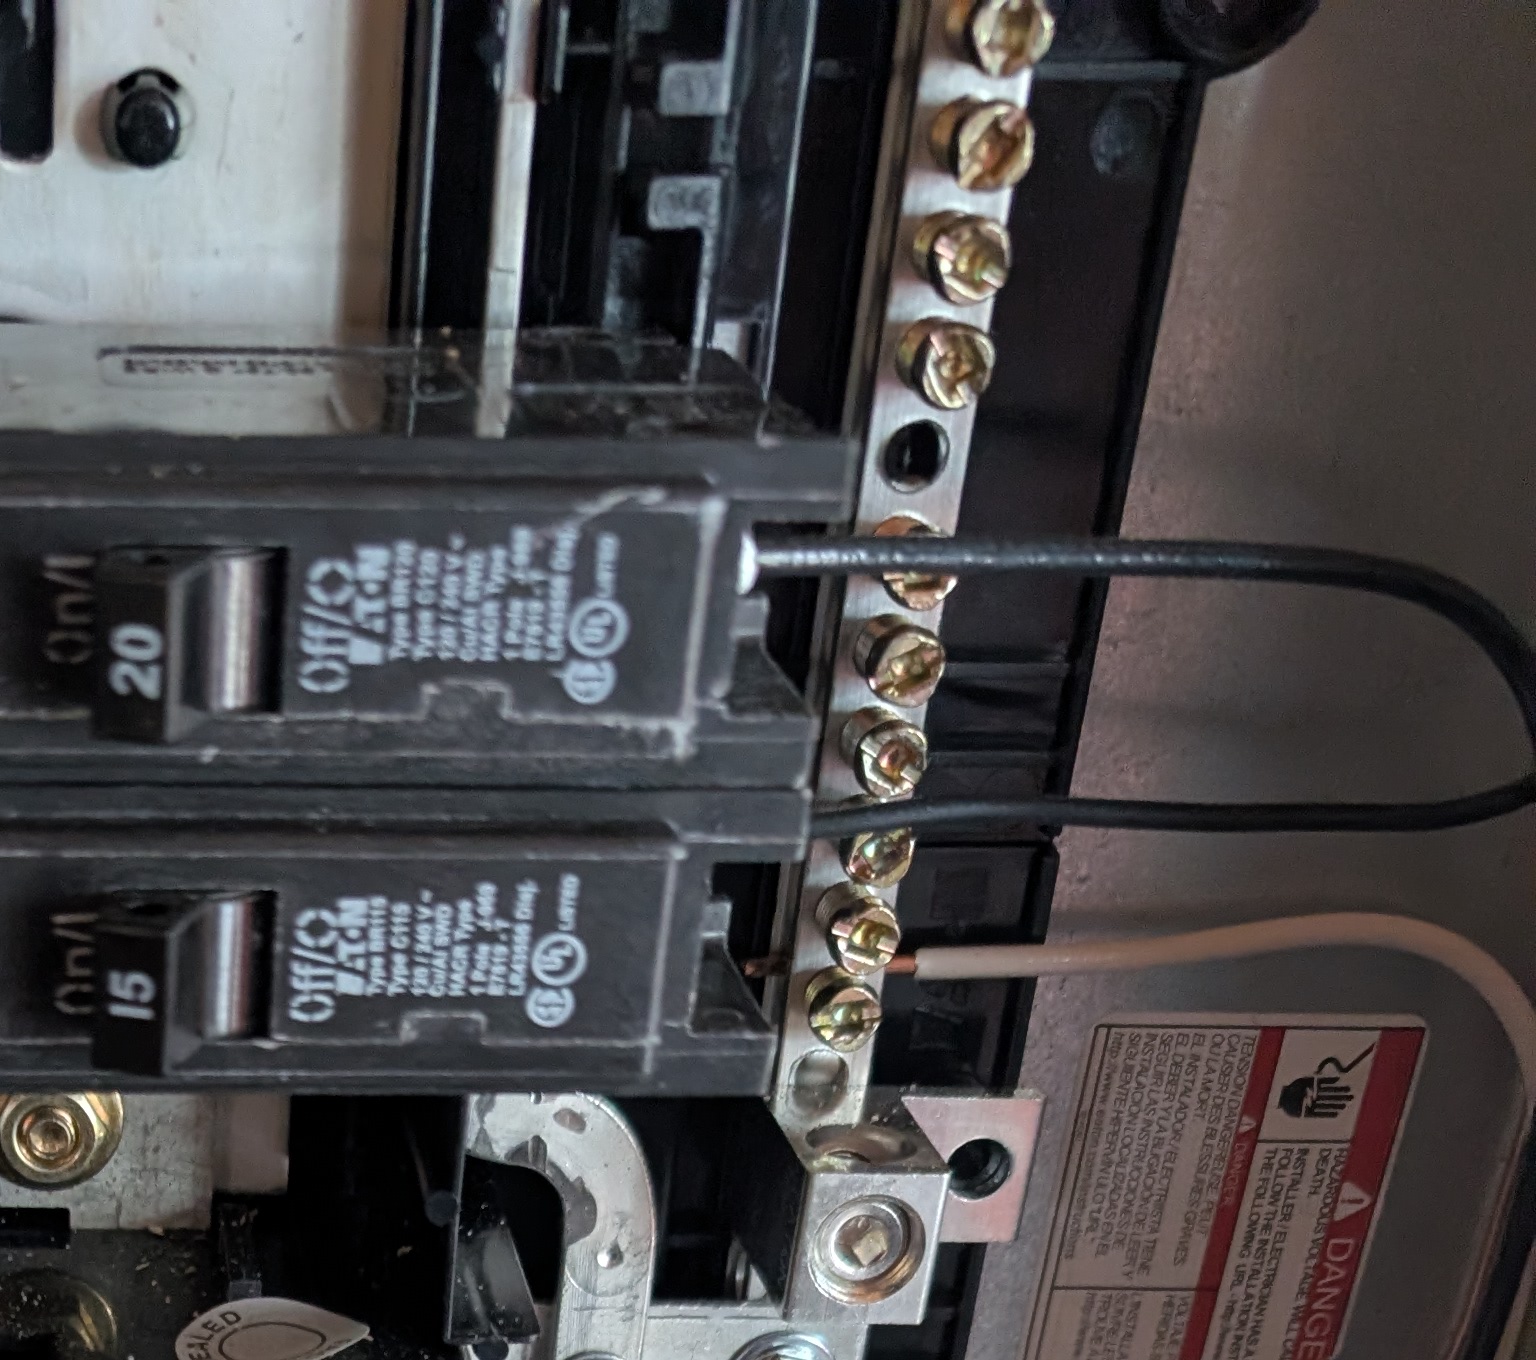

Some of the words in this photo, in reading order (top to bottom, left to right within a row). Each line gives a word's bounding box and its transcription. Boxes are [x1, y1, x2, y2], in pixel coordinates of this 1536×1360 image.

[109, 622, 163, 700] 20
[107, 970, 156, 1020] 15
[1149, 1032, 1174, 1087] SEGUIR
[1173, 1032, 1190, 1052] EL
[1190, 1033, 1205, 1051] EL
[1202, 1058, 1219, 1075] LA
[1207, 1033, 1226, 1056] OU
[1215, 1034, 1242, 1093] CAUSER
[1229, 1034, 1257, 1098] TENSION
[1112, 1032, 1142, 1109] SIGUIENTE
[1162, 1054, 1185, 1102] DEBER
[1142, 1088, 1161, 1116] LAS
[1207, 1096, 1226, 1124] DES
[1258, 1147, 1278, 1176] THE
[1267, 1147, 1294, 1206] FOLLOW
[1278, 1147, 1309, 1222] INSTALLER
[1238, 1177, 1271, 1258] FOLLOWING
